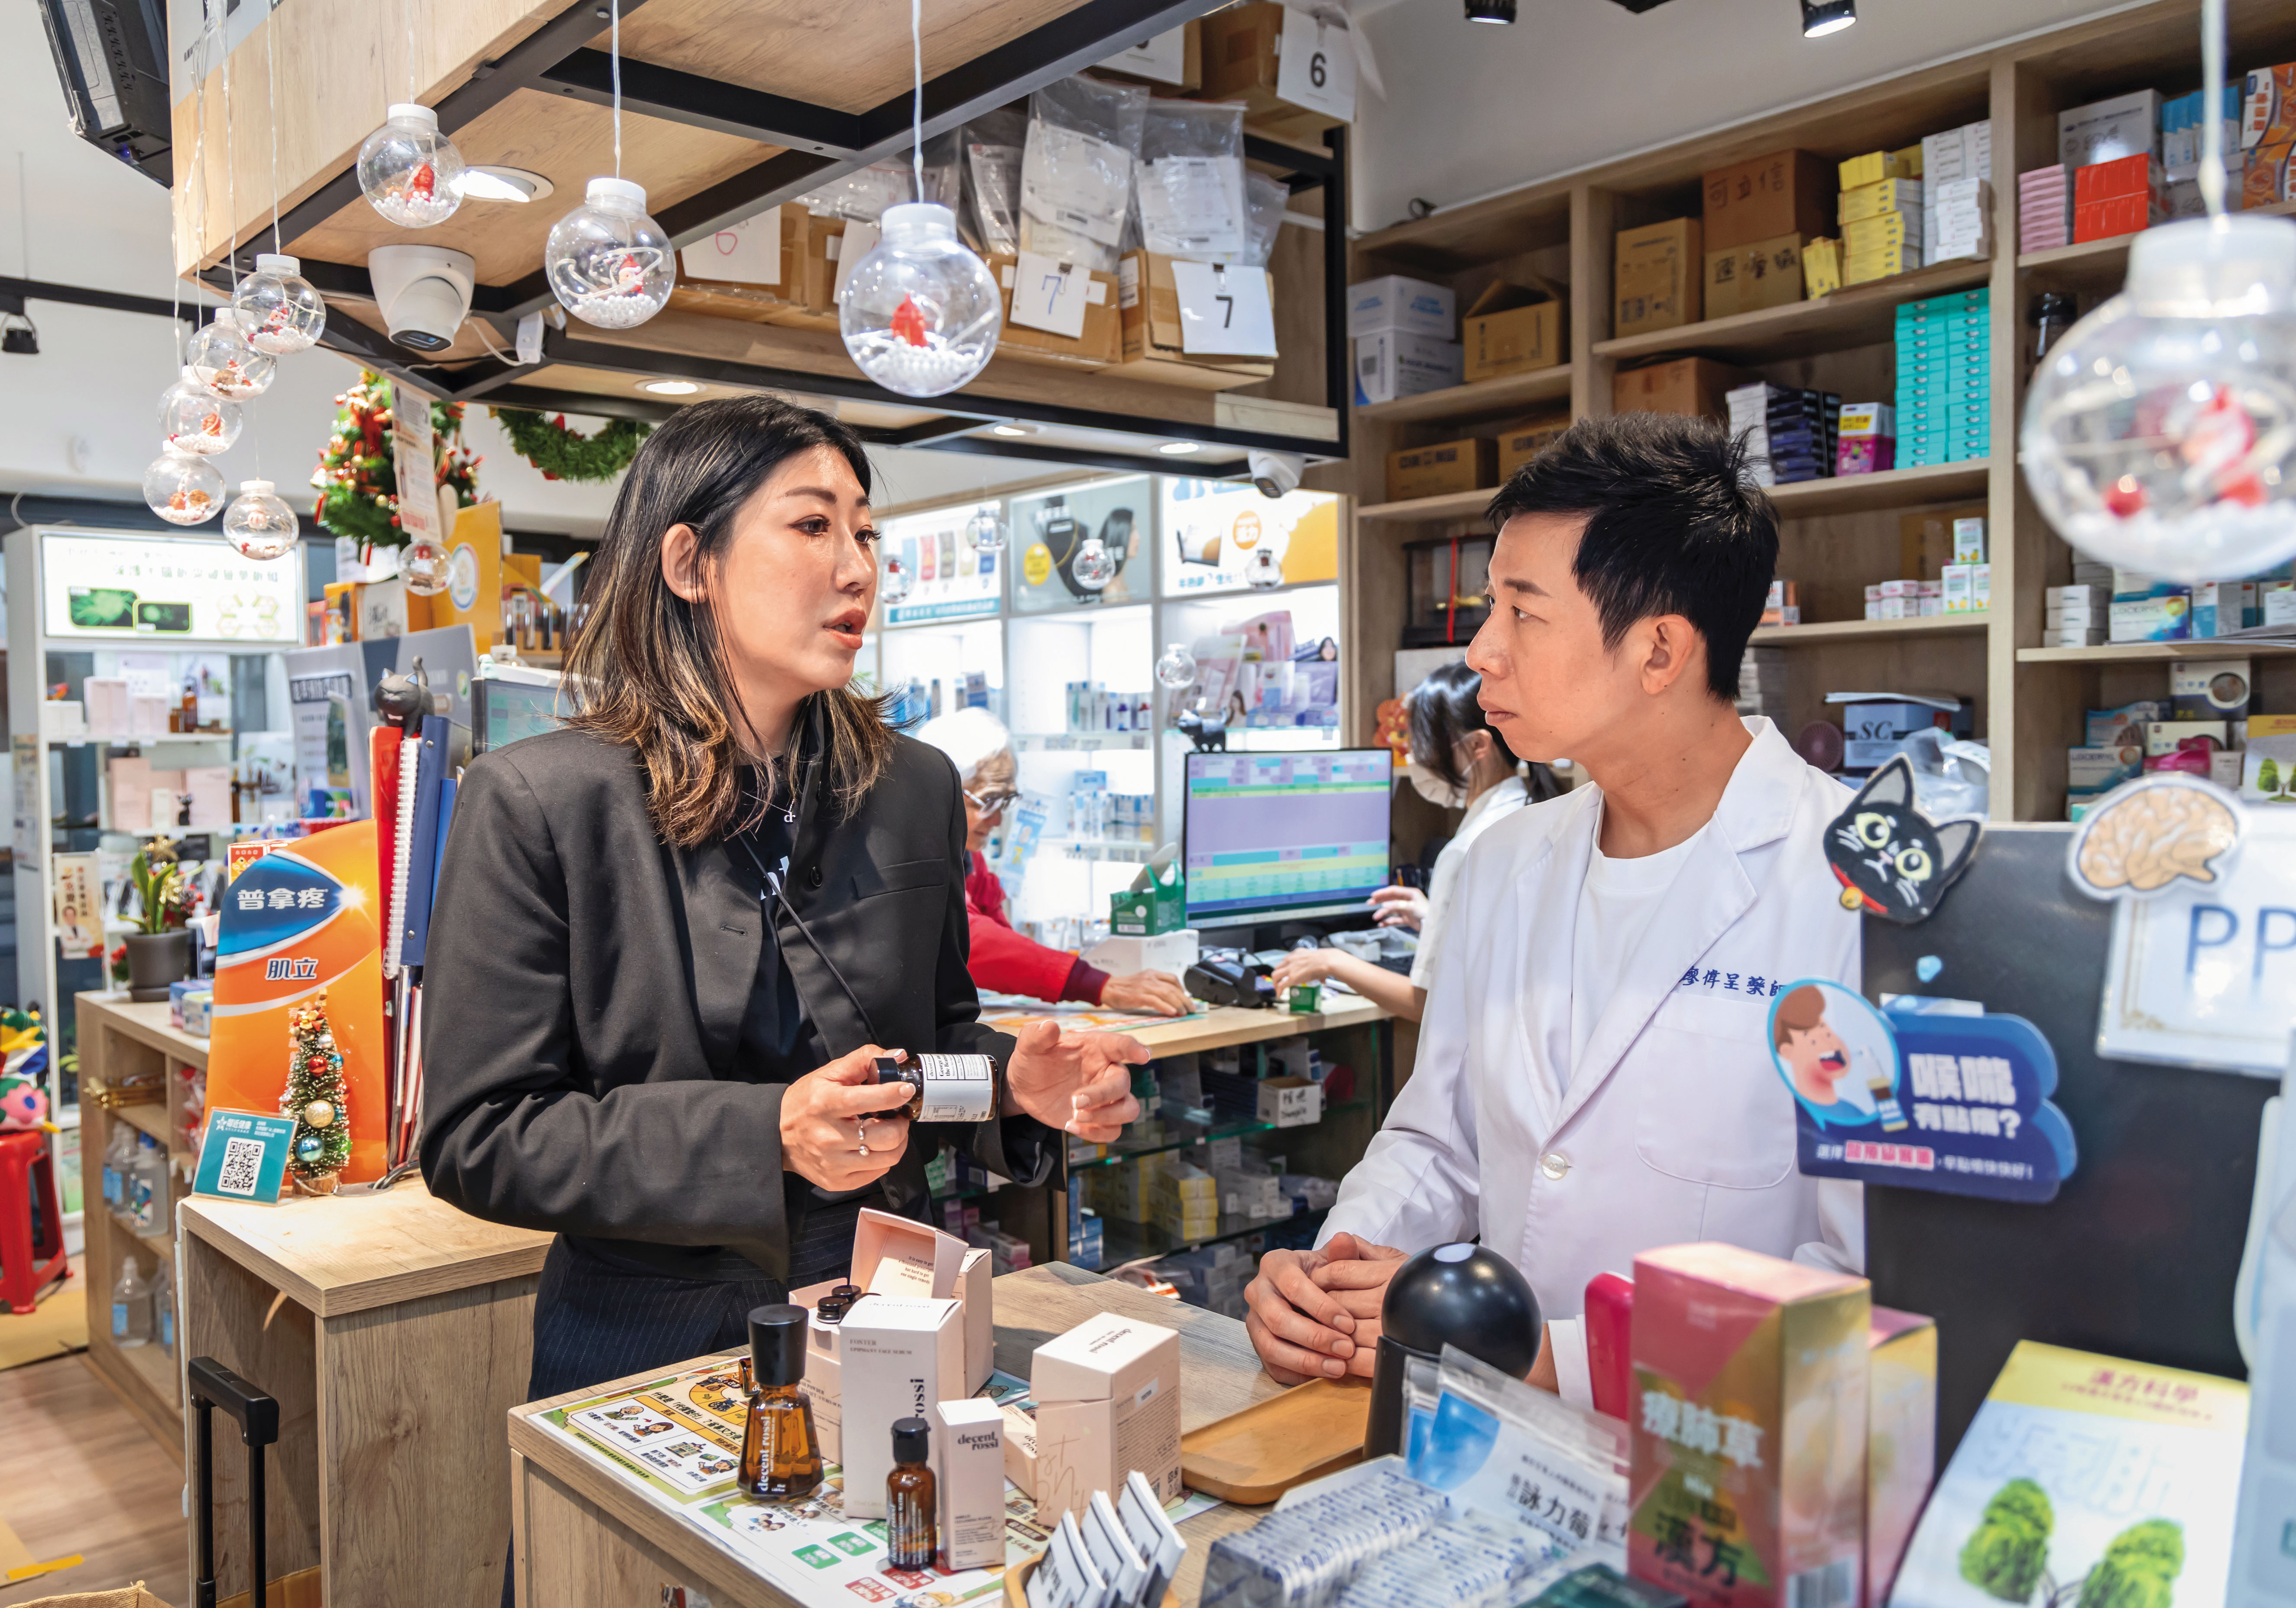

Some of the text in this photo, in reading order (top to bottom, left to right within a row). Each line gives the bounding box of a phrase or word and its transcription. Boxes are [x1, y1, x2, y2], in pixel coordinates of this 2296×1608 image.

[1310, 52, 1327, 87] 6
[1216, 296, 1232, 328] 7
[1862, 721, 1893, 740] SC
[237, 888, 326, 910] 普拿疼
[266, 958, 318, 980] 肌立
[1910, 1054, 2016, 1105] 喉嚨
[958, 1431, 997, 1446] decent
[972, 1439, 999, 1451] rossi
[757, 1416, 772, 1491] decent rossi
